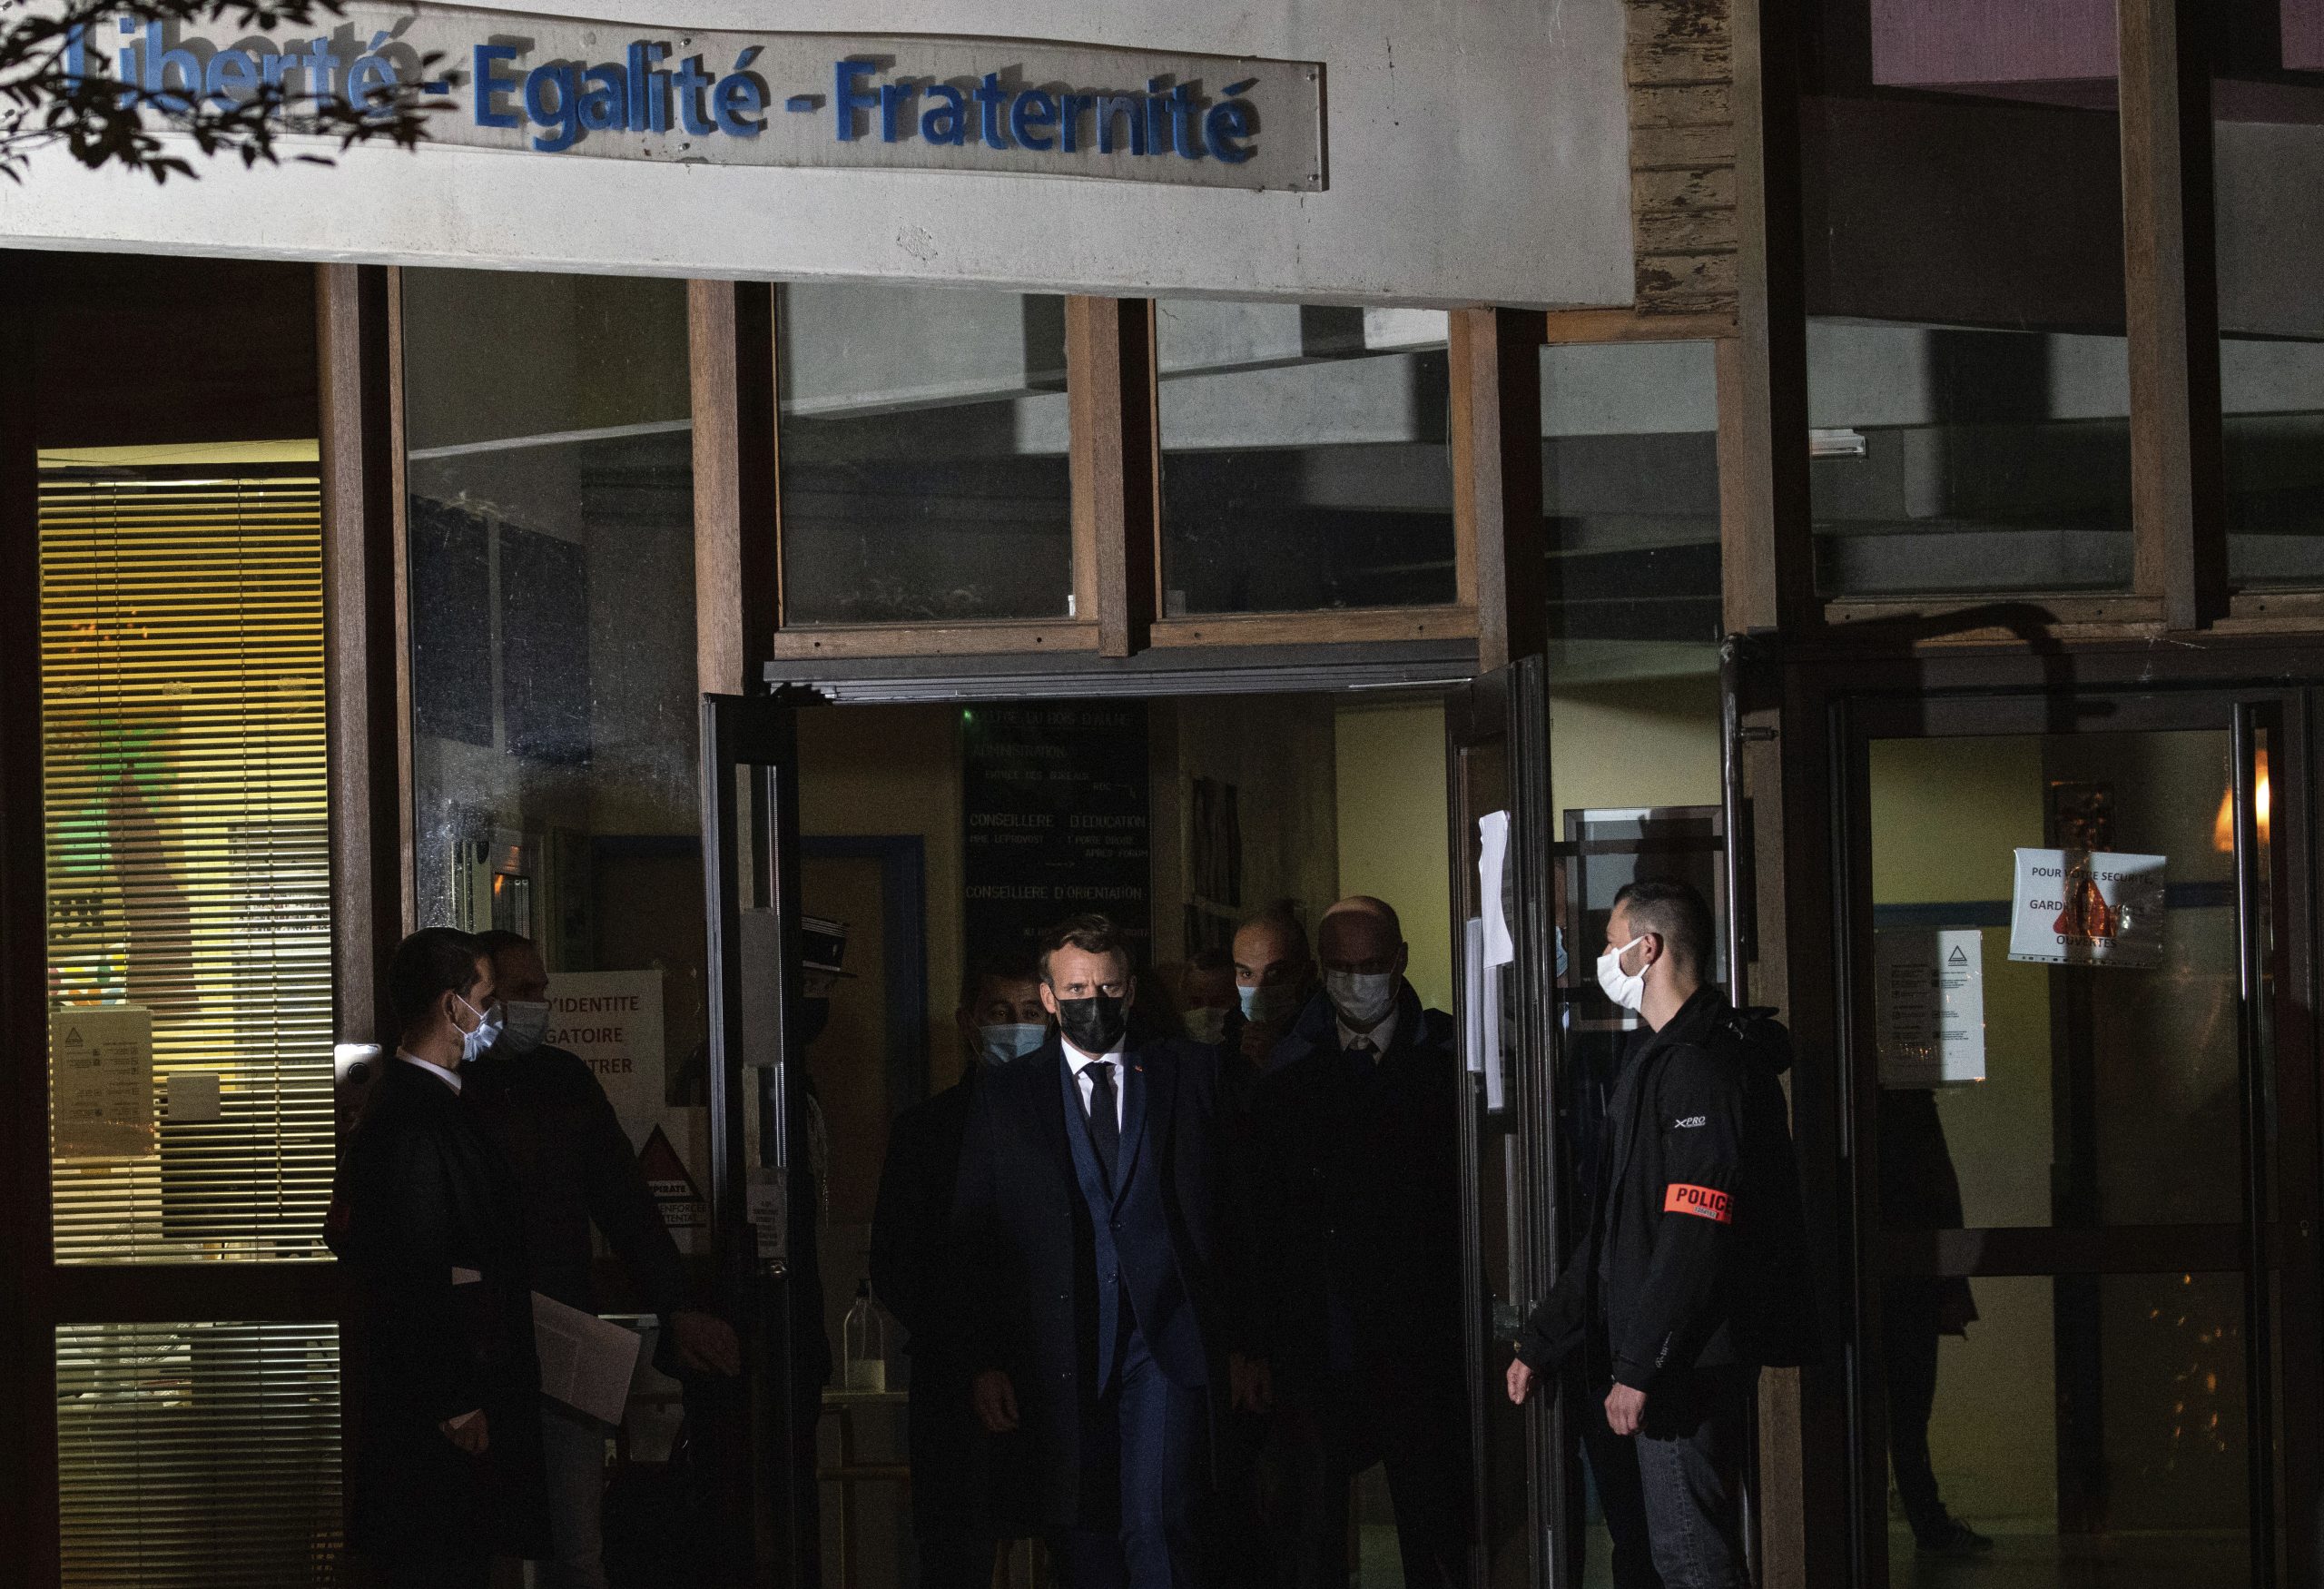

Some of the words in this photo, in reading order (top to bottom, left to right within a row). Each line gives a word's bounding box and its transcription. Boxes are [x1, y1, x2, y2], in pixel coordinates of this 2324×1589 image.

[474, 40, 763, 153] Egalité
[835, 61, 1256, 164] Fraternité
[2032, 866, 2062, 878] POUR
[2030, 899, 2069, 912] GARD
[545, 1027, 623, 1044] GATOIRE
[584, 1057, 633, 1074] TRER
[653, 1185, 686, 1193] PIRATE
